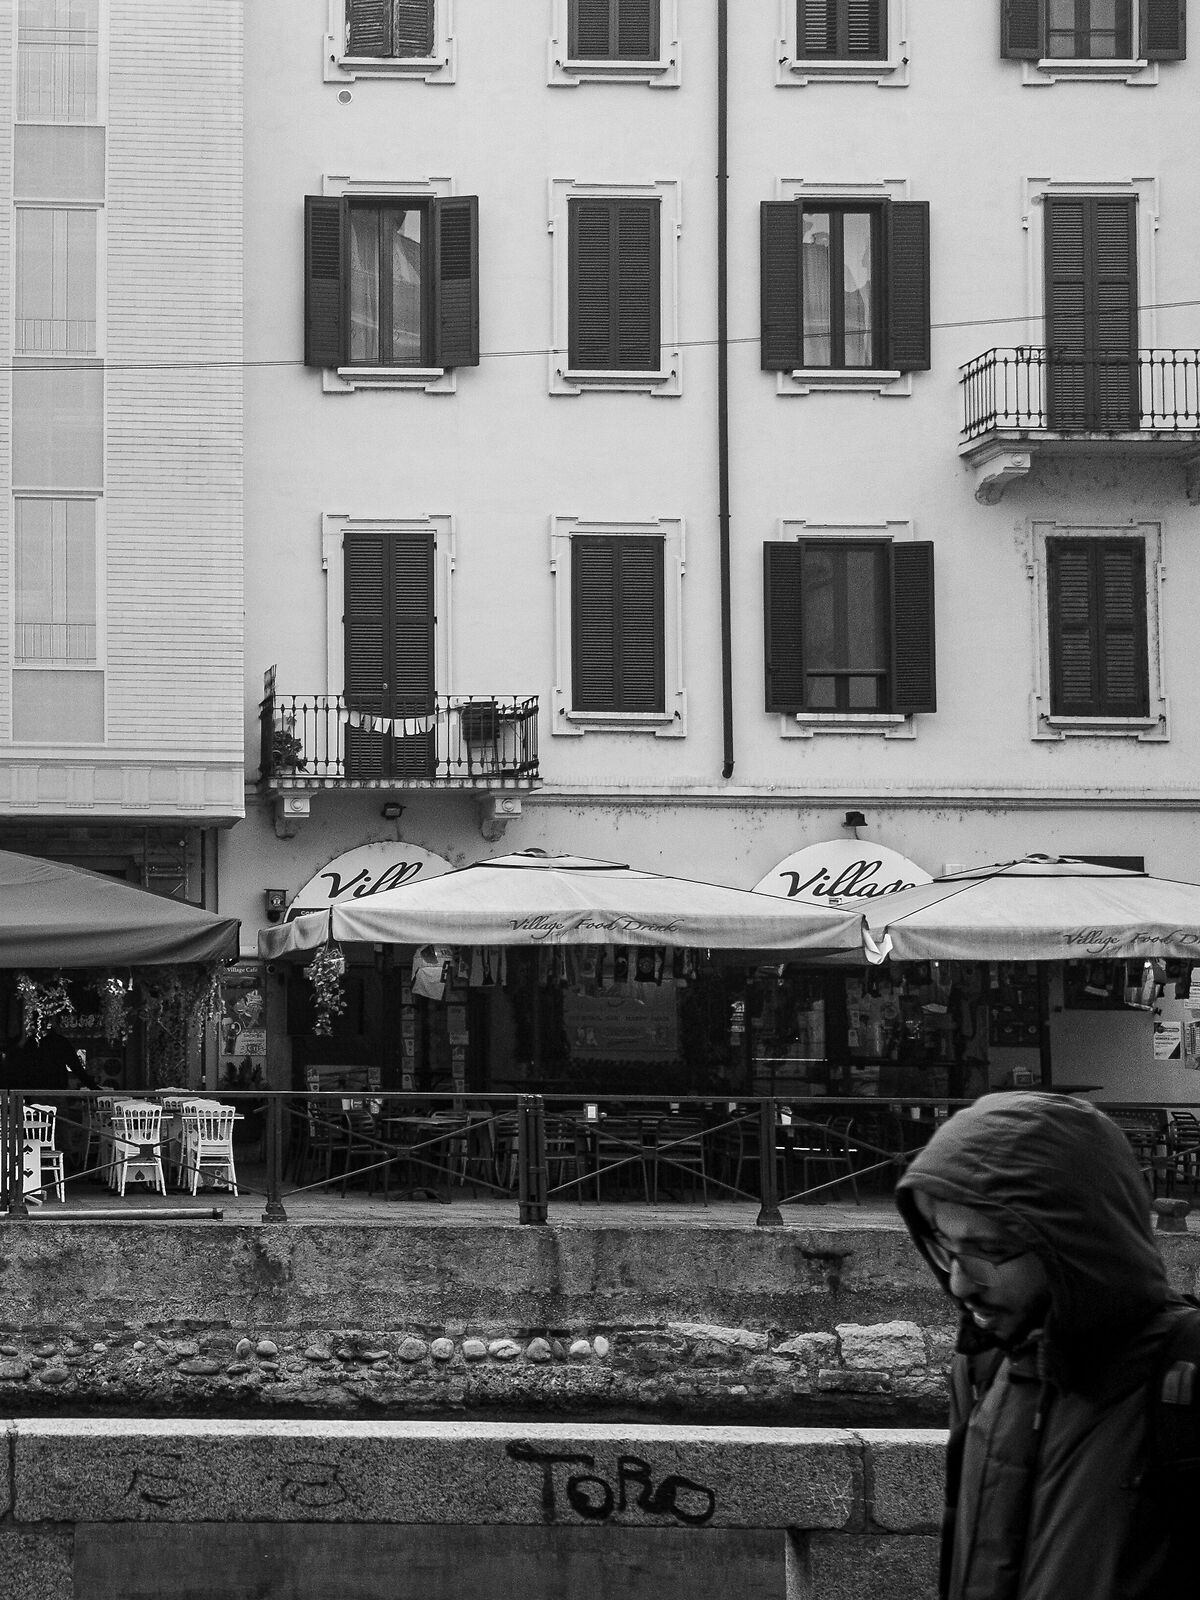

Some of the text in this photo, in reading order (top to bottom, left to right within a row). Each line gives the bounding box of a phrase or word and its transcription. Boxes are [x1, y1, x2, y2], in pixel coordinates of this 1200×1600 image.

[510, 914, 685, 940] Village Food Drink
[1063, 929, 1121, 954] Village
[1128, 929, 1184, 945] Food
